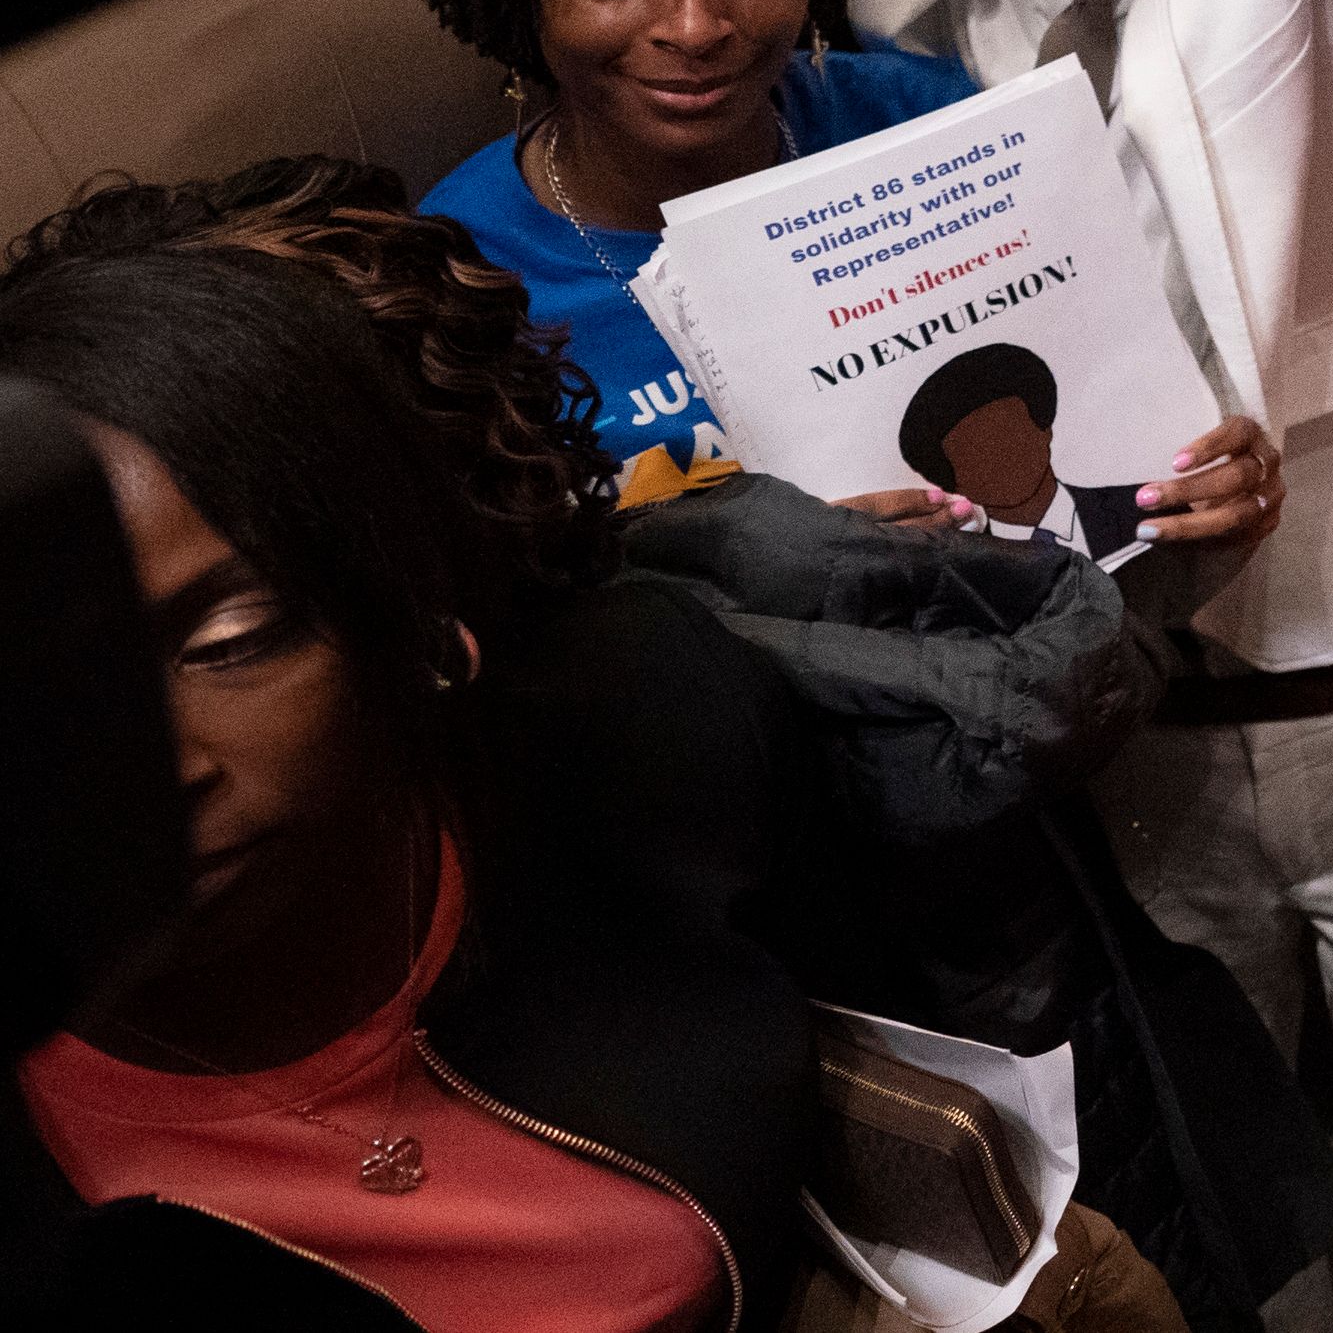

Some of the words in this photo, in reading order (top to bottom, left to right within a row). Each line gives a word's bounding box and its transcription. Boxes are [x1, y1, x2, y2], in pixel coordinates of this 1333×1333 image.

[764, 193, 865, 241] District
[872, 177, 904, 202] 86
[911, 143, 996, 187] stands
[1001, 129, 1026, 149] in
[790, 205, 913, 263] solidarity
[919, 179, 976, 213] with
[982, 162, 1023, 188] our
[812, 193, 1016, 287] Representative!
[828, 286, 901, 329] Don't
[904, 250, 990, 300] silence
[996, 229, 1031, 260] us!
[809, 351, 865, 392] NO
[869, 255, 1078, 370] EXPULSION!
